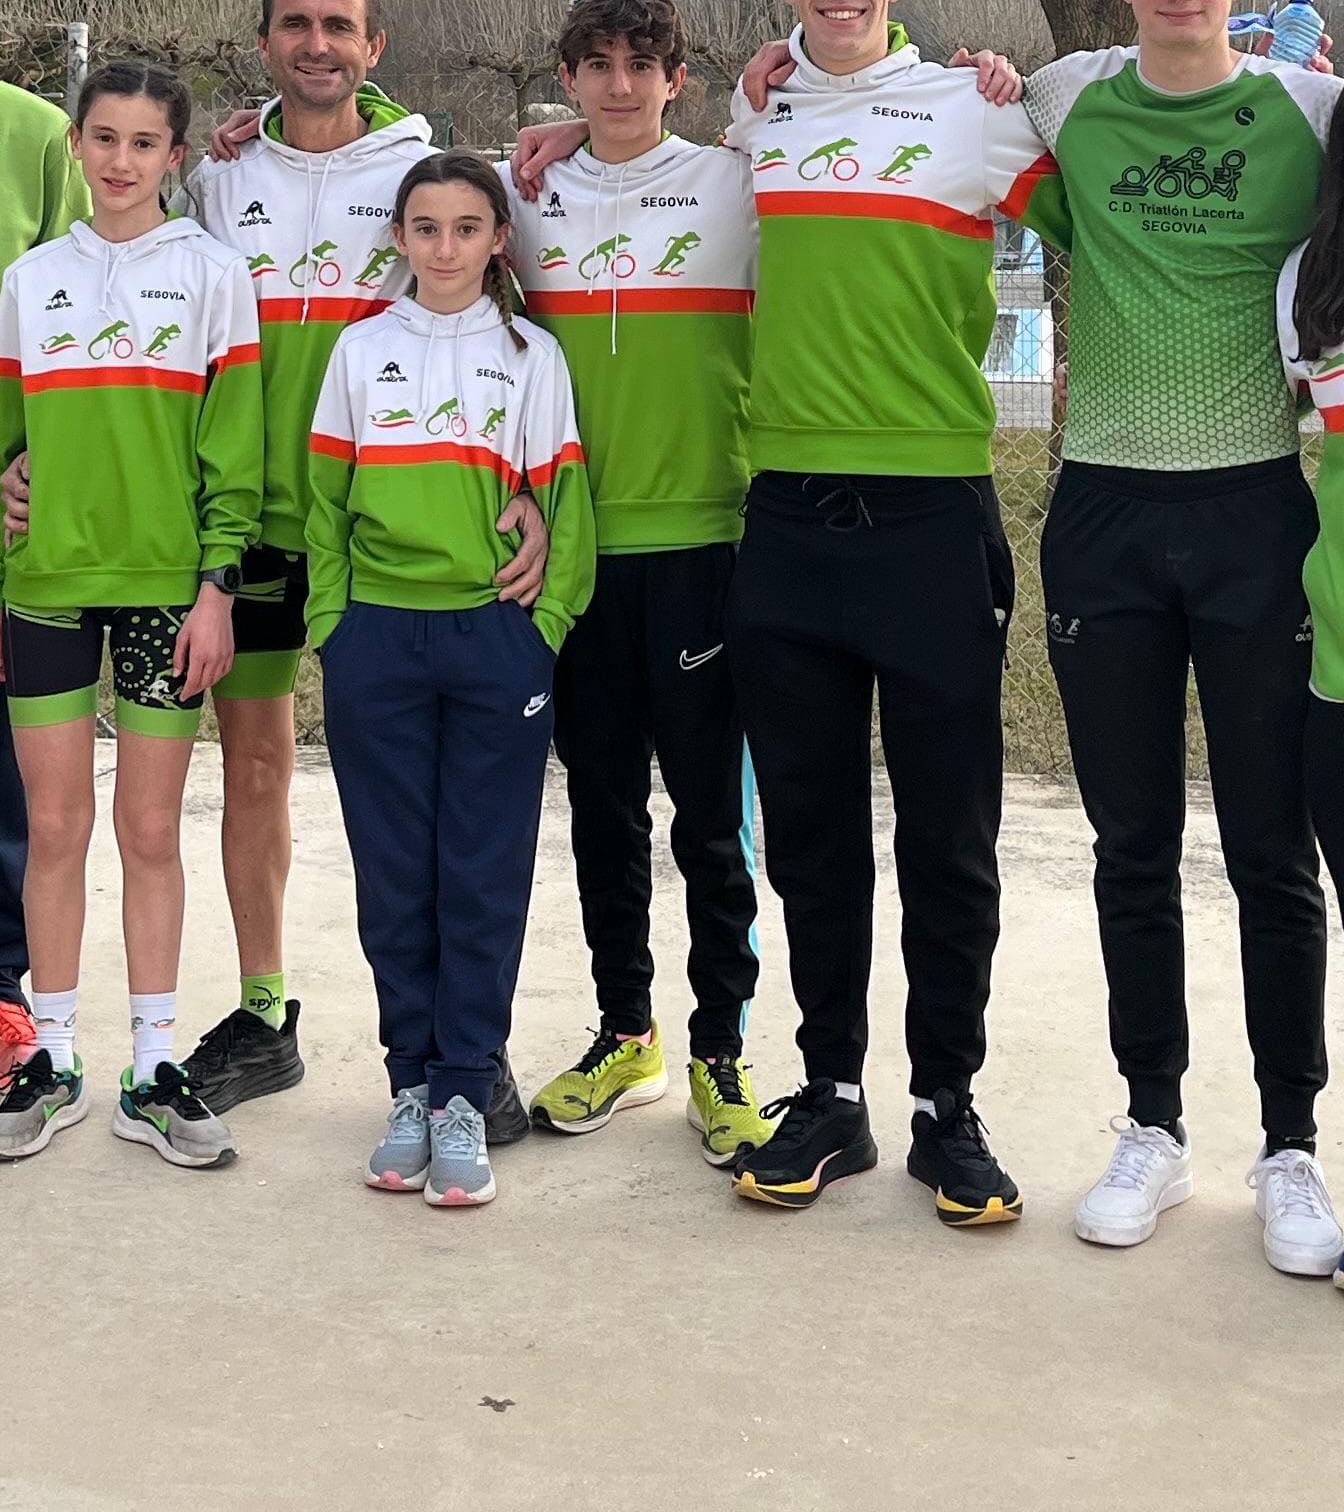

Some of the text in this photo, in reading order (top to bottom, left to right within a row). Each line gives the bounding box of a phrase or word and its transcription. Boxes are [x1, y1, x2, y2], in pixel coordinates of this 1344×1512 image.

[871, 106, 934, 122] SEGOVIA
[640, 197, 698, 207] SEGOVIA
[1108, 201, 1245, 219] C.D. Triatlón Lacerta
[1141, 220, 1207, 234] SEGOVIA
[140, 290, 186, 301] SEGOVIA
